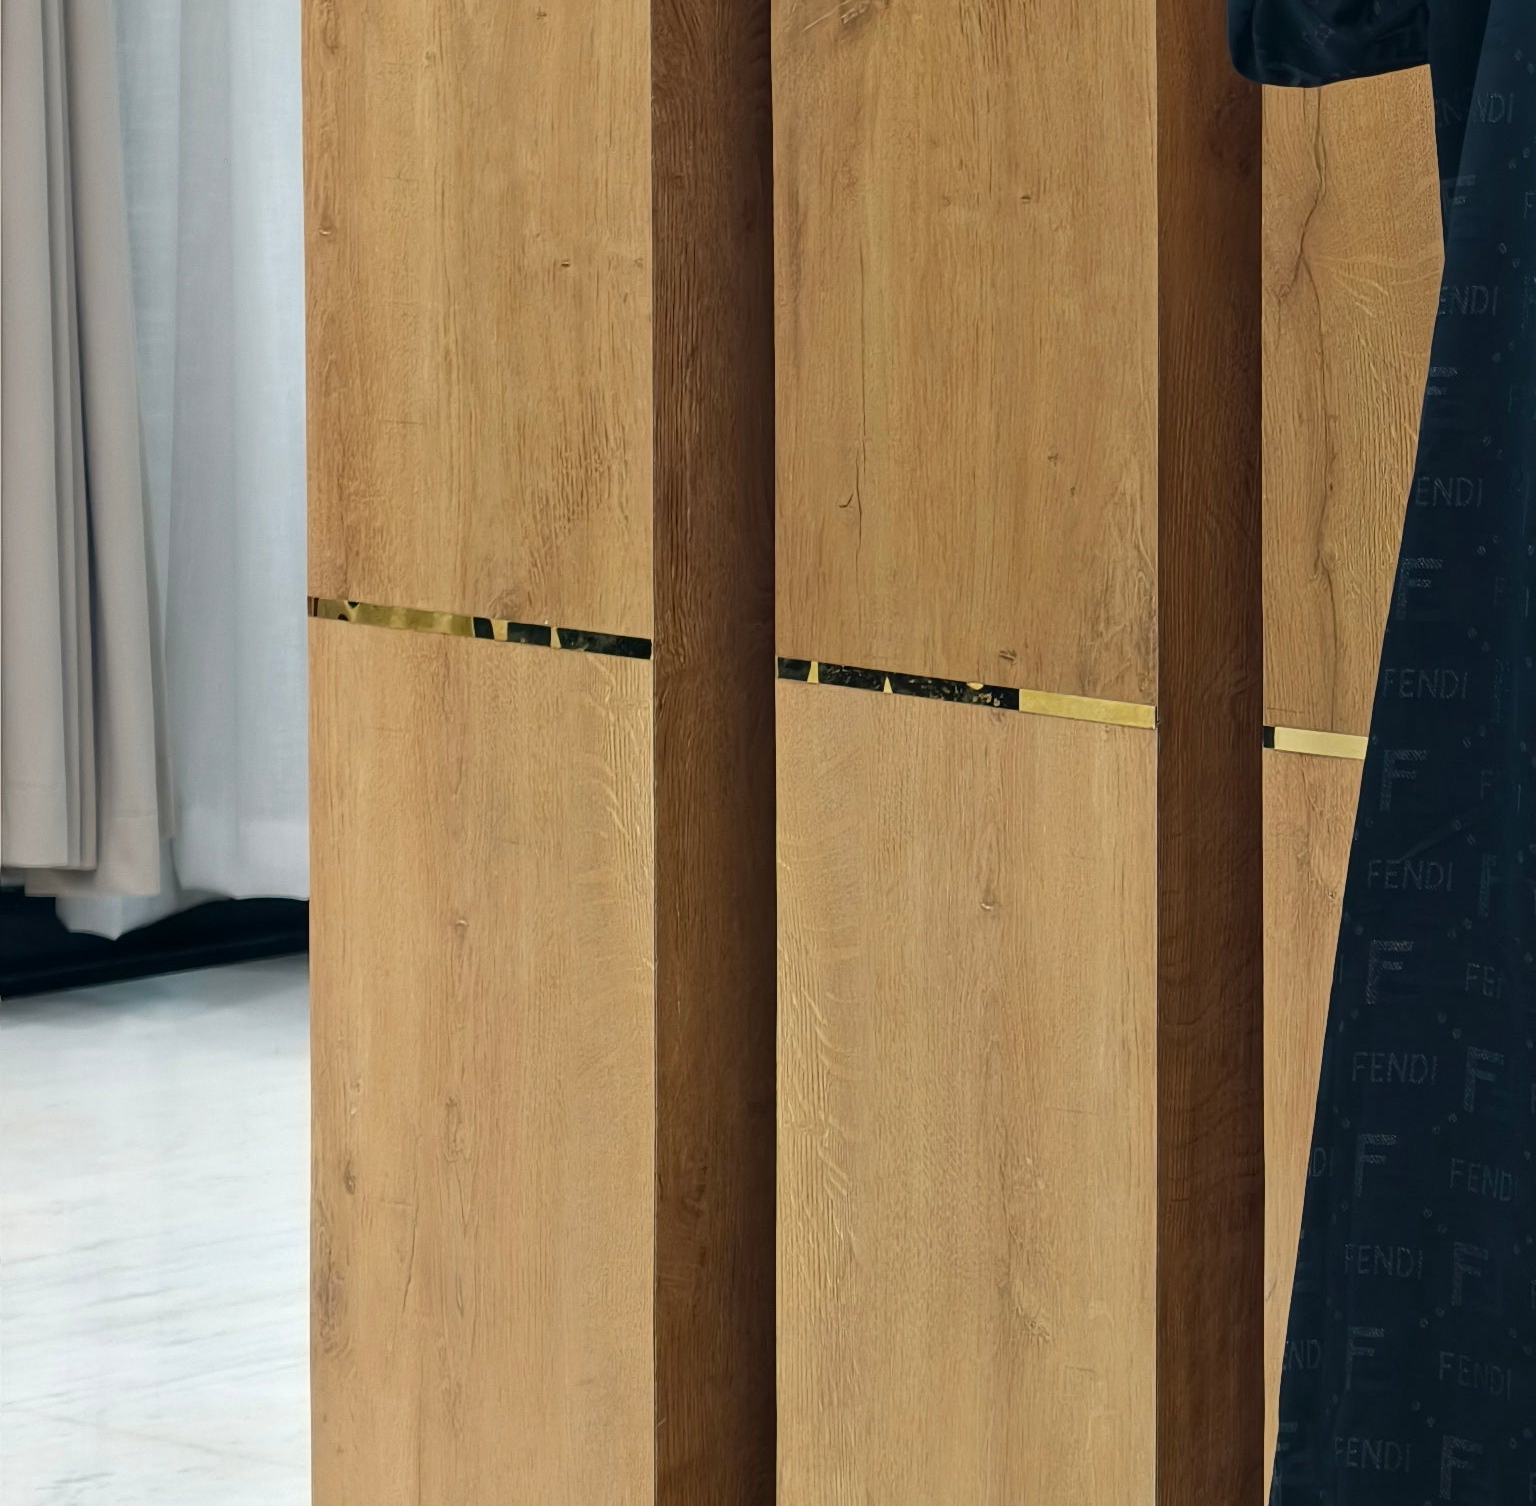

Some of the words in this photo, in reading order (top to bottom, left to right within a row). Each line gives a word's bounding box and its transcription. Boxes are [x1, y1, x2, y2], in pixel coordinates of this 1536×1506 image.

[1416, 478, 1483, 508] ENDI
[1382, 668, 1468, 700] FENDI
[1379, 750, 1430, 812] F
[1367, 859, 1454, 892] FENDI
[1364, 940, 1414, 1004] F
[1352, 1051, 1439, 1085] FENDI
[1463, 1045, 1504, 1113] F
[1353, 1133, 1399, 1196] F
[1448, 1157, 1520, 1203] FENDI
[1344, 1243, 1425, 1279] FENDI
[1451, 1241, 1489, 1307] F
[1345, 1325, 1385, 1391] F
[1438, 1350, 1512, 1400] FENDI
[1334, 1436, 1414, 1473] FENDI
[1439, 1433, 1483, 1500] F
